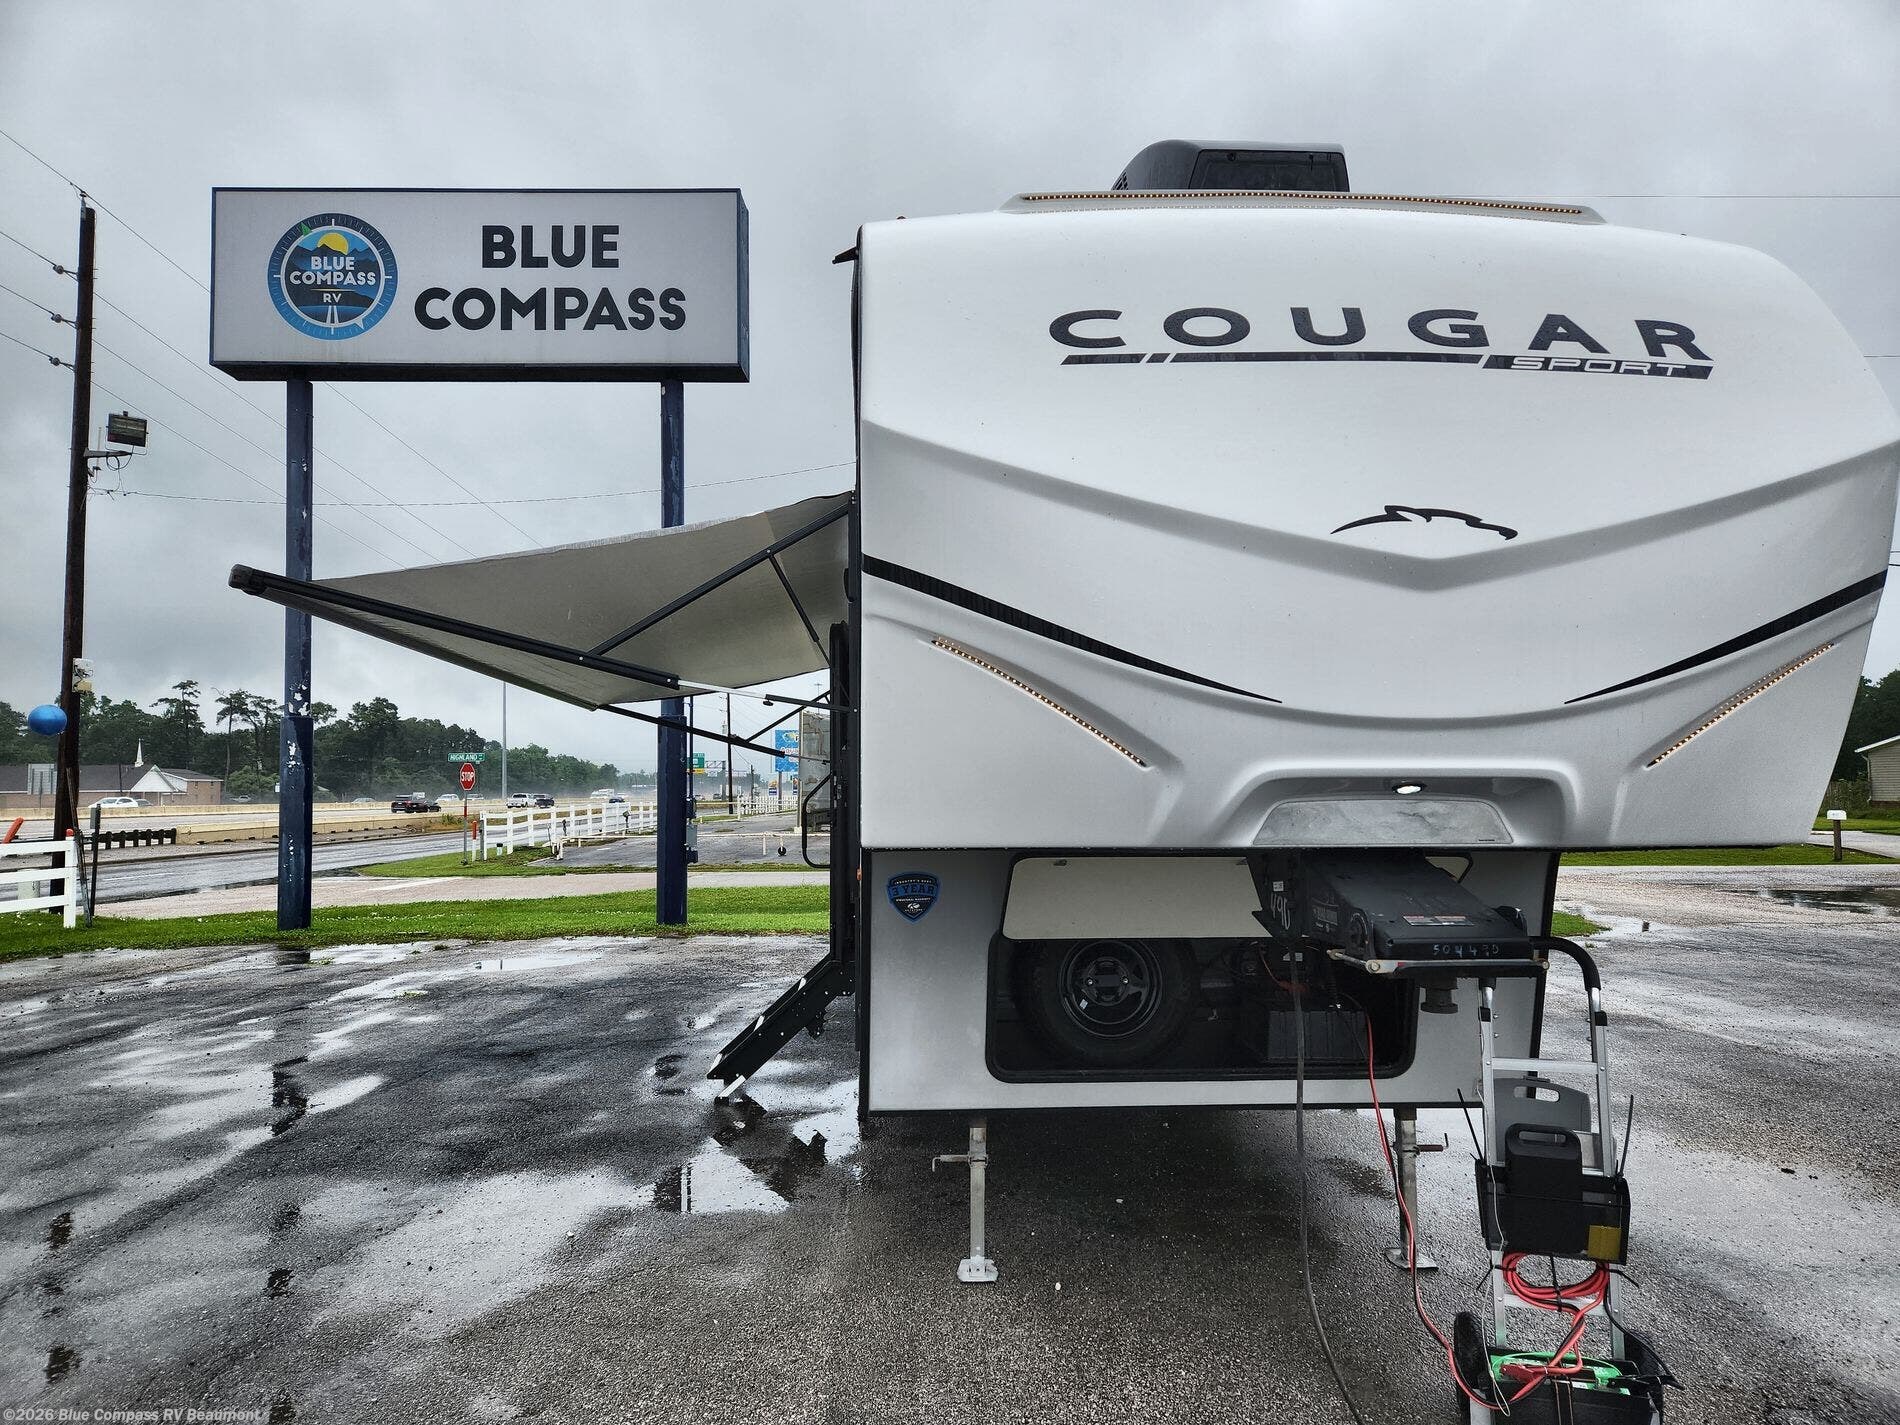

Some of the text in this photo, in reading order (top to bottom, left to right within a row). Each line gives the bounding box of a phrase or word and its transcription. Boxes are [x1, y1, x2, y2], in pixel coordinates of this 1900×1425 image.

[481, 225, 620, 268] BLUE
[310, 256, 355, 270] BLUE
[289, 271, 376, 286] COMPASS
[323, 293, 342, 303] RV
[414, 287, 687, 331] COMPASS
[1049, 306, 1714, 362] COUGAR
[1511, 356, 1687, 376] SPORT
[461, 772, 474, 782] STOP
[903, 885, 934, 894] YEAR
